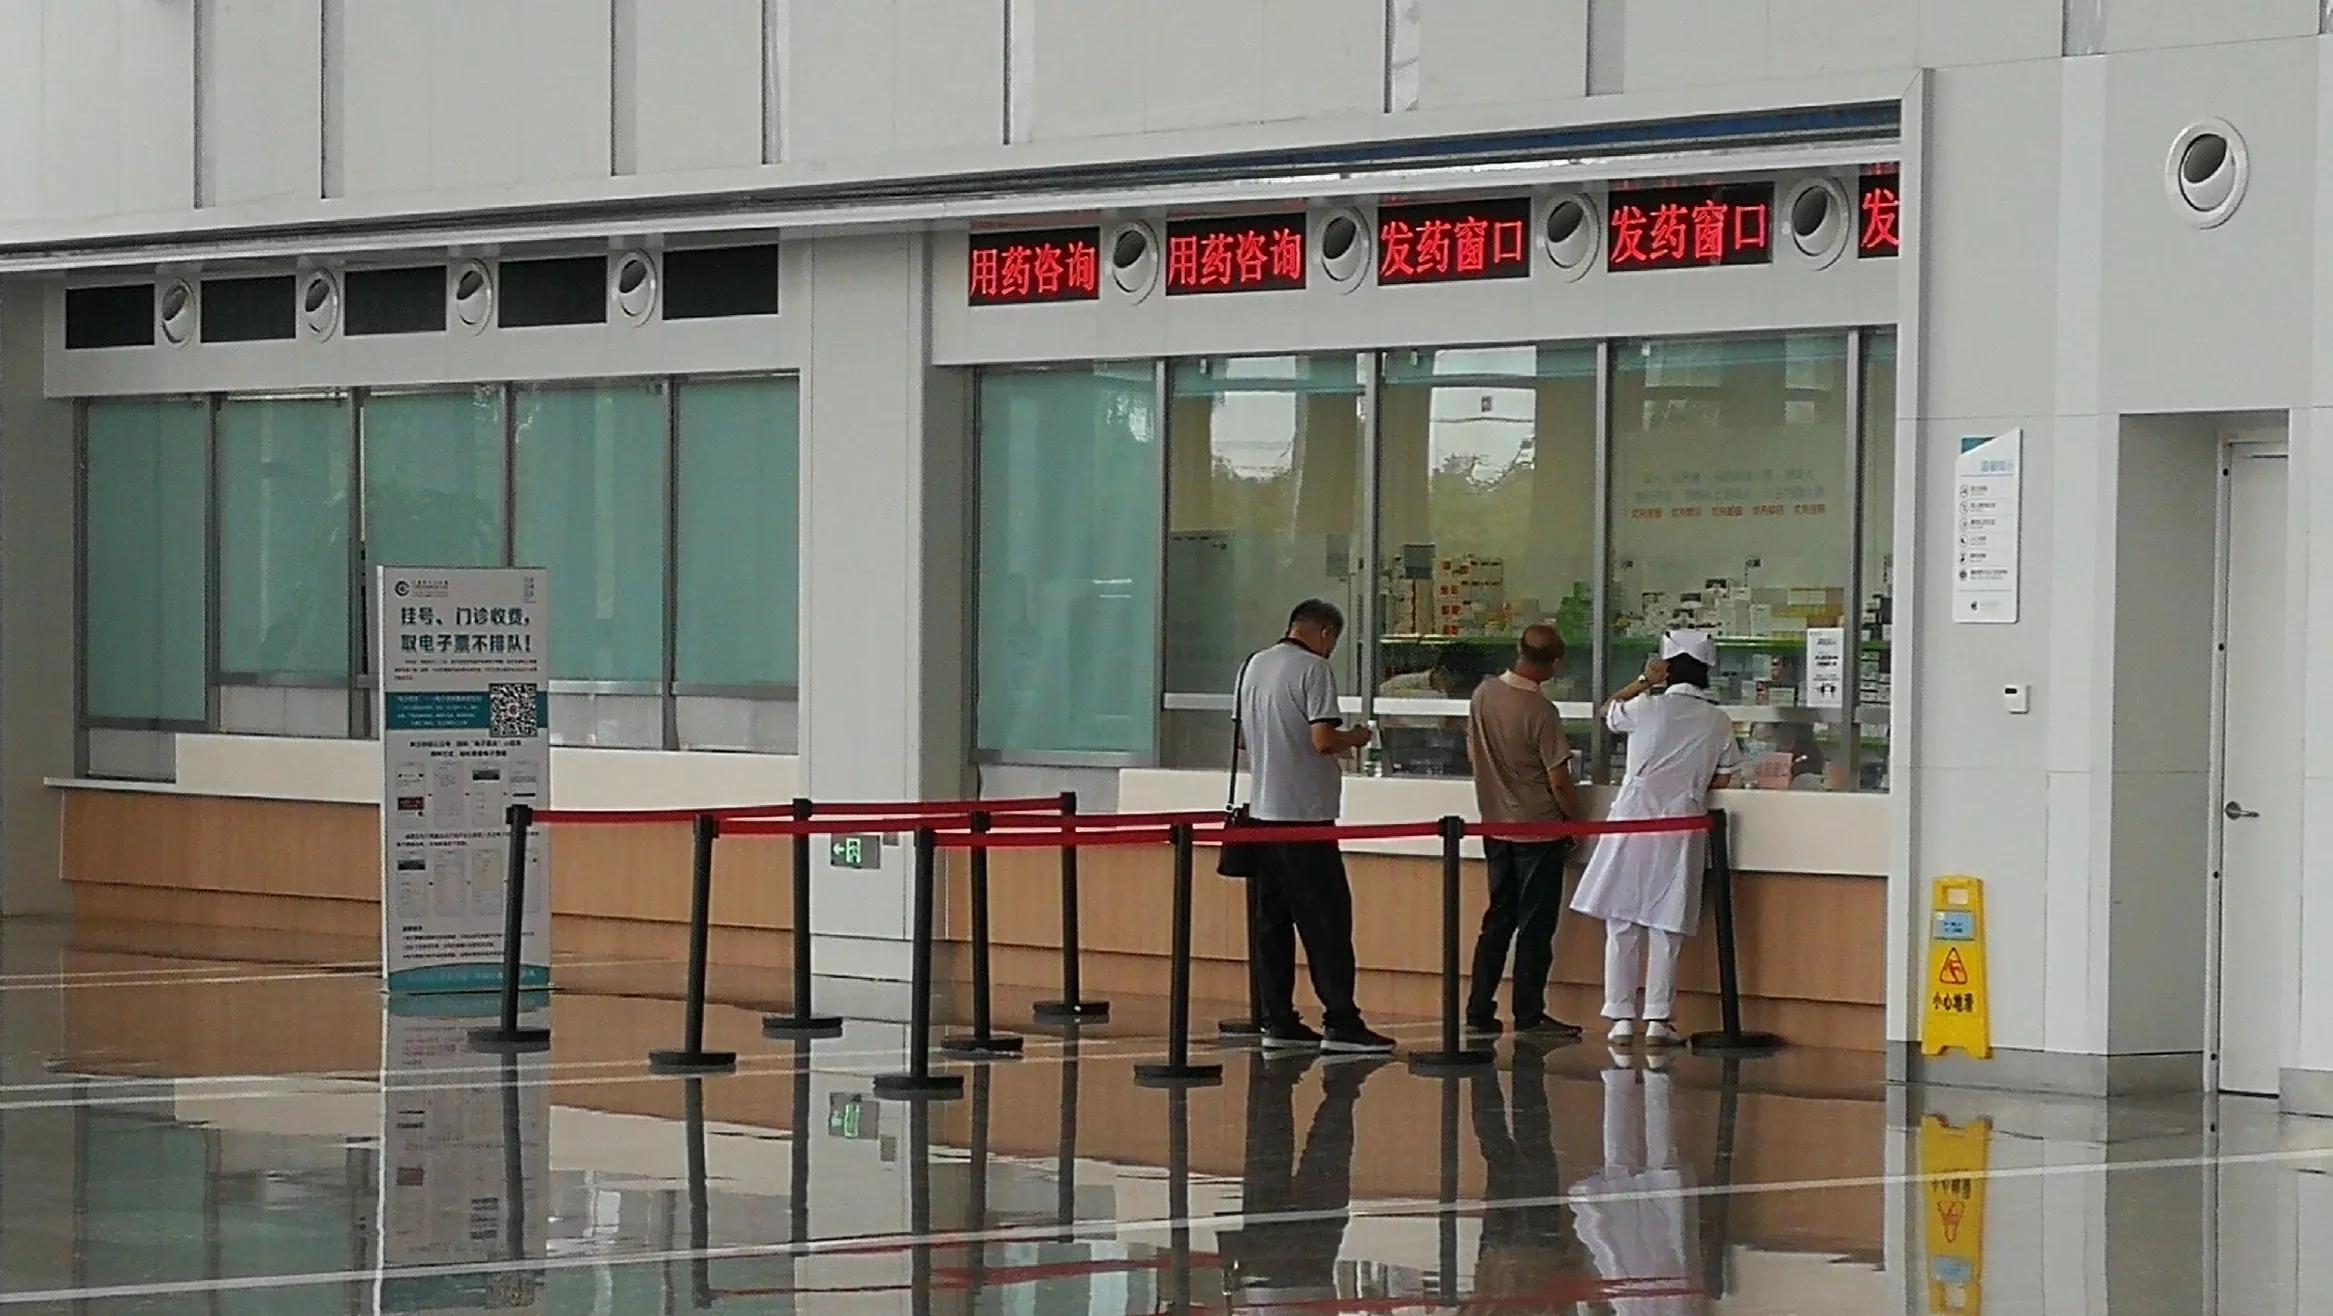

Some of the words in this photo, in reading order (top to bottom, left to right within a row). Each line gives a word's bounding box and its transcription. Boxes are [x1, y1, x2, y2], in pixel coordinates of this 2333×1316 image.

[1380, 215, 1523, 277] 发药窗口
[1611, 200, 1767, 264] 发药窗口
[1862, 188, 1899, 248] 发
[971, 241, 1096, 296] 用药咨询
[1168, 228, 1302, 286] 用药咨询
